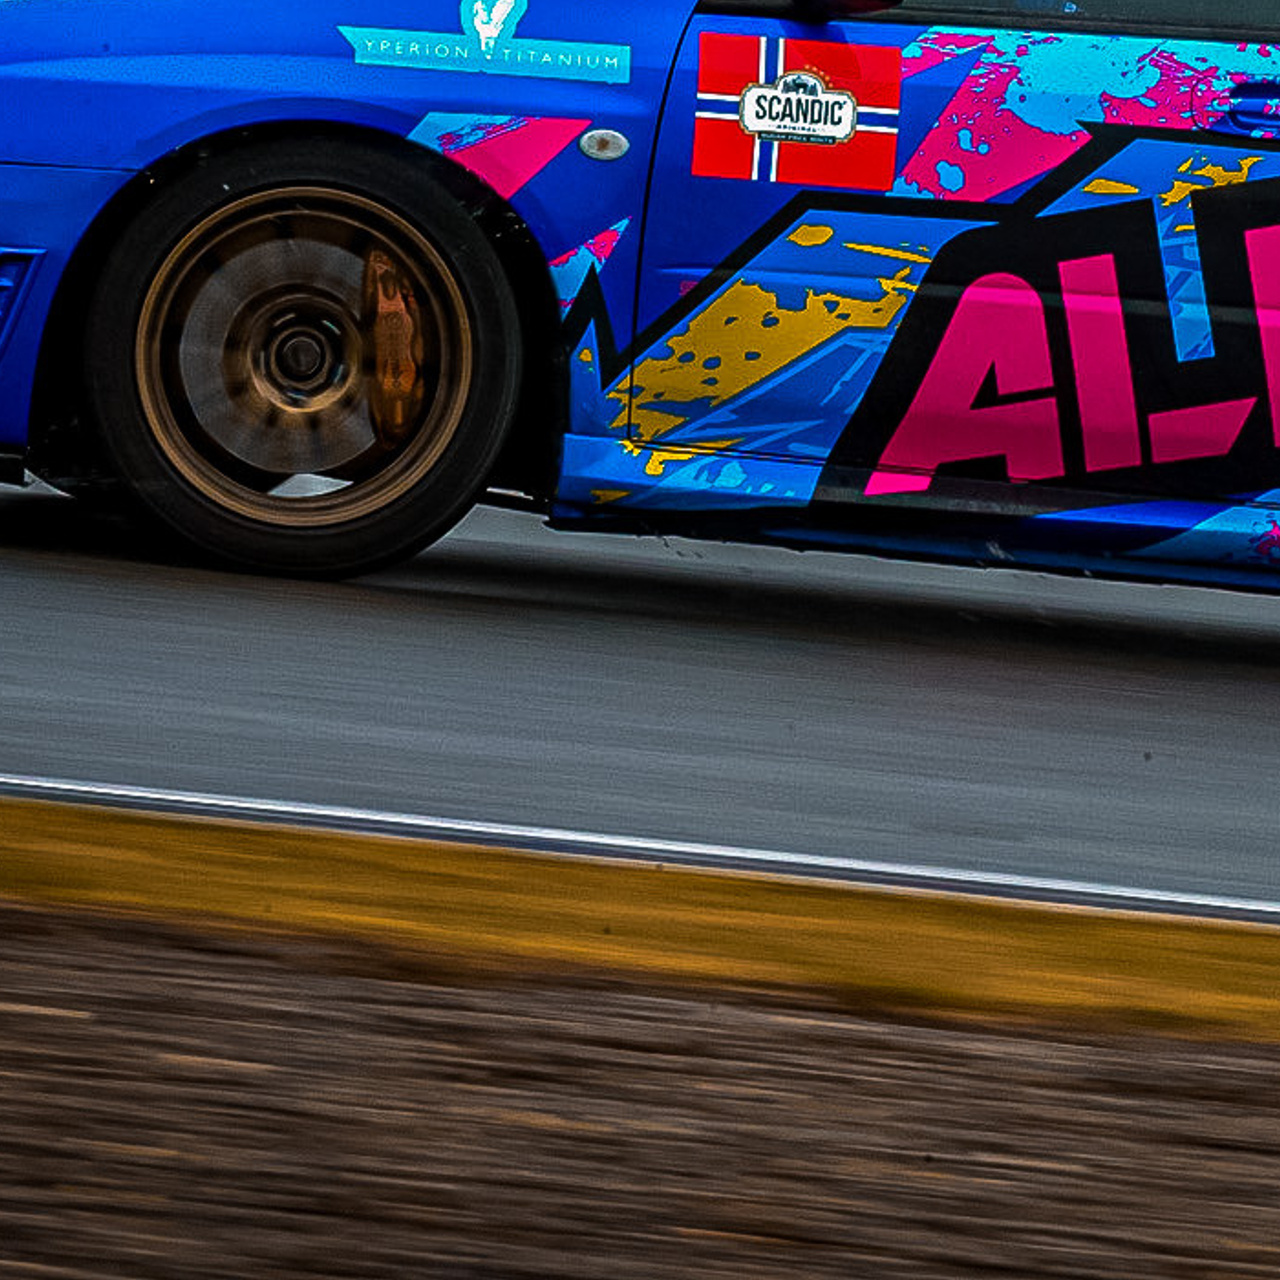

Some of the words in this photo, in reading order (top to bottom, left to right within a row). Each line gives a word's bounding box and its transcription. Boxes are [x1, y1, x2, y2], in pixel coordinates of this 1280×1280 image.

[364, 39, 469, 59] YPERION
[503, 48, 619, 69] TITANIUM
[755, 94, 843, 126] SCANDIC
